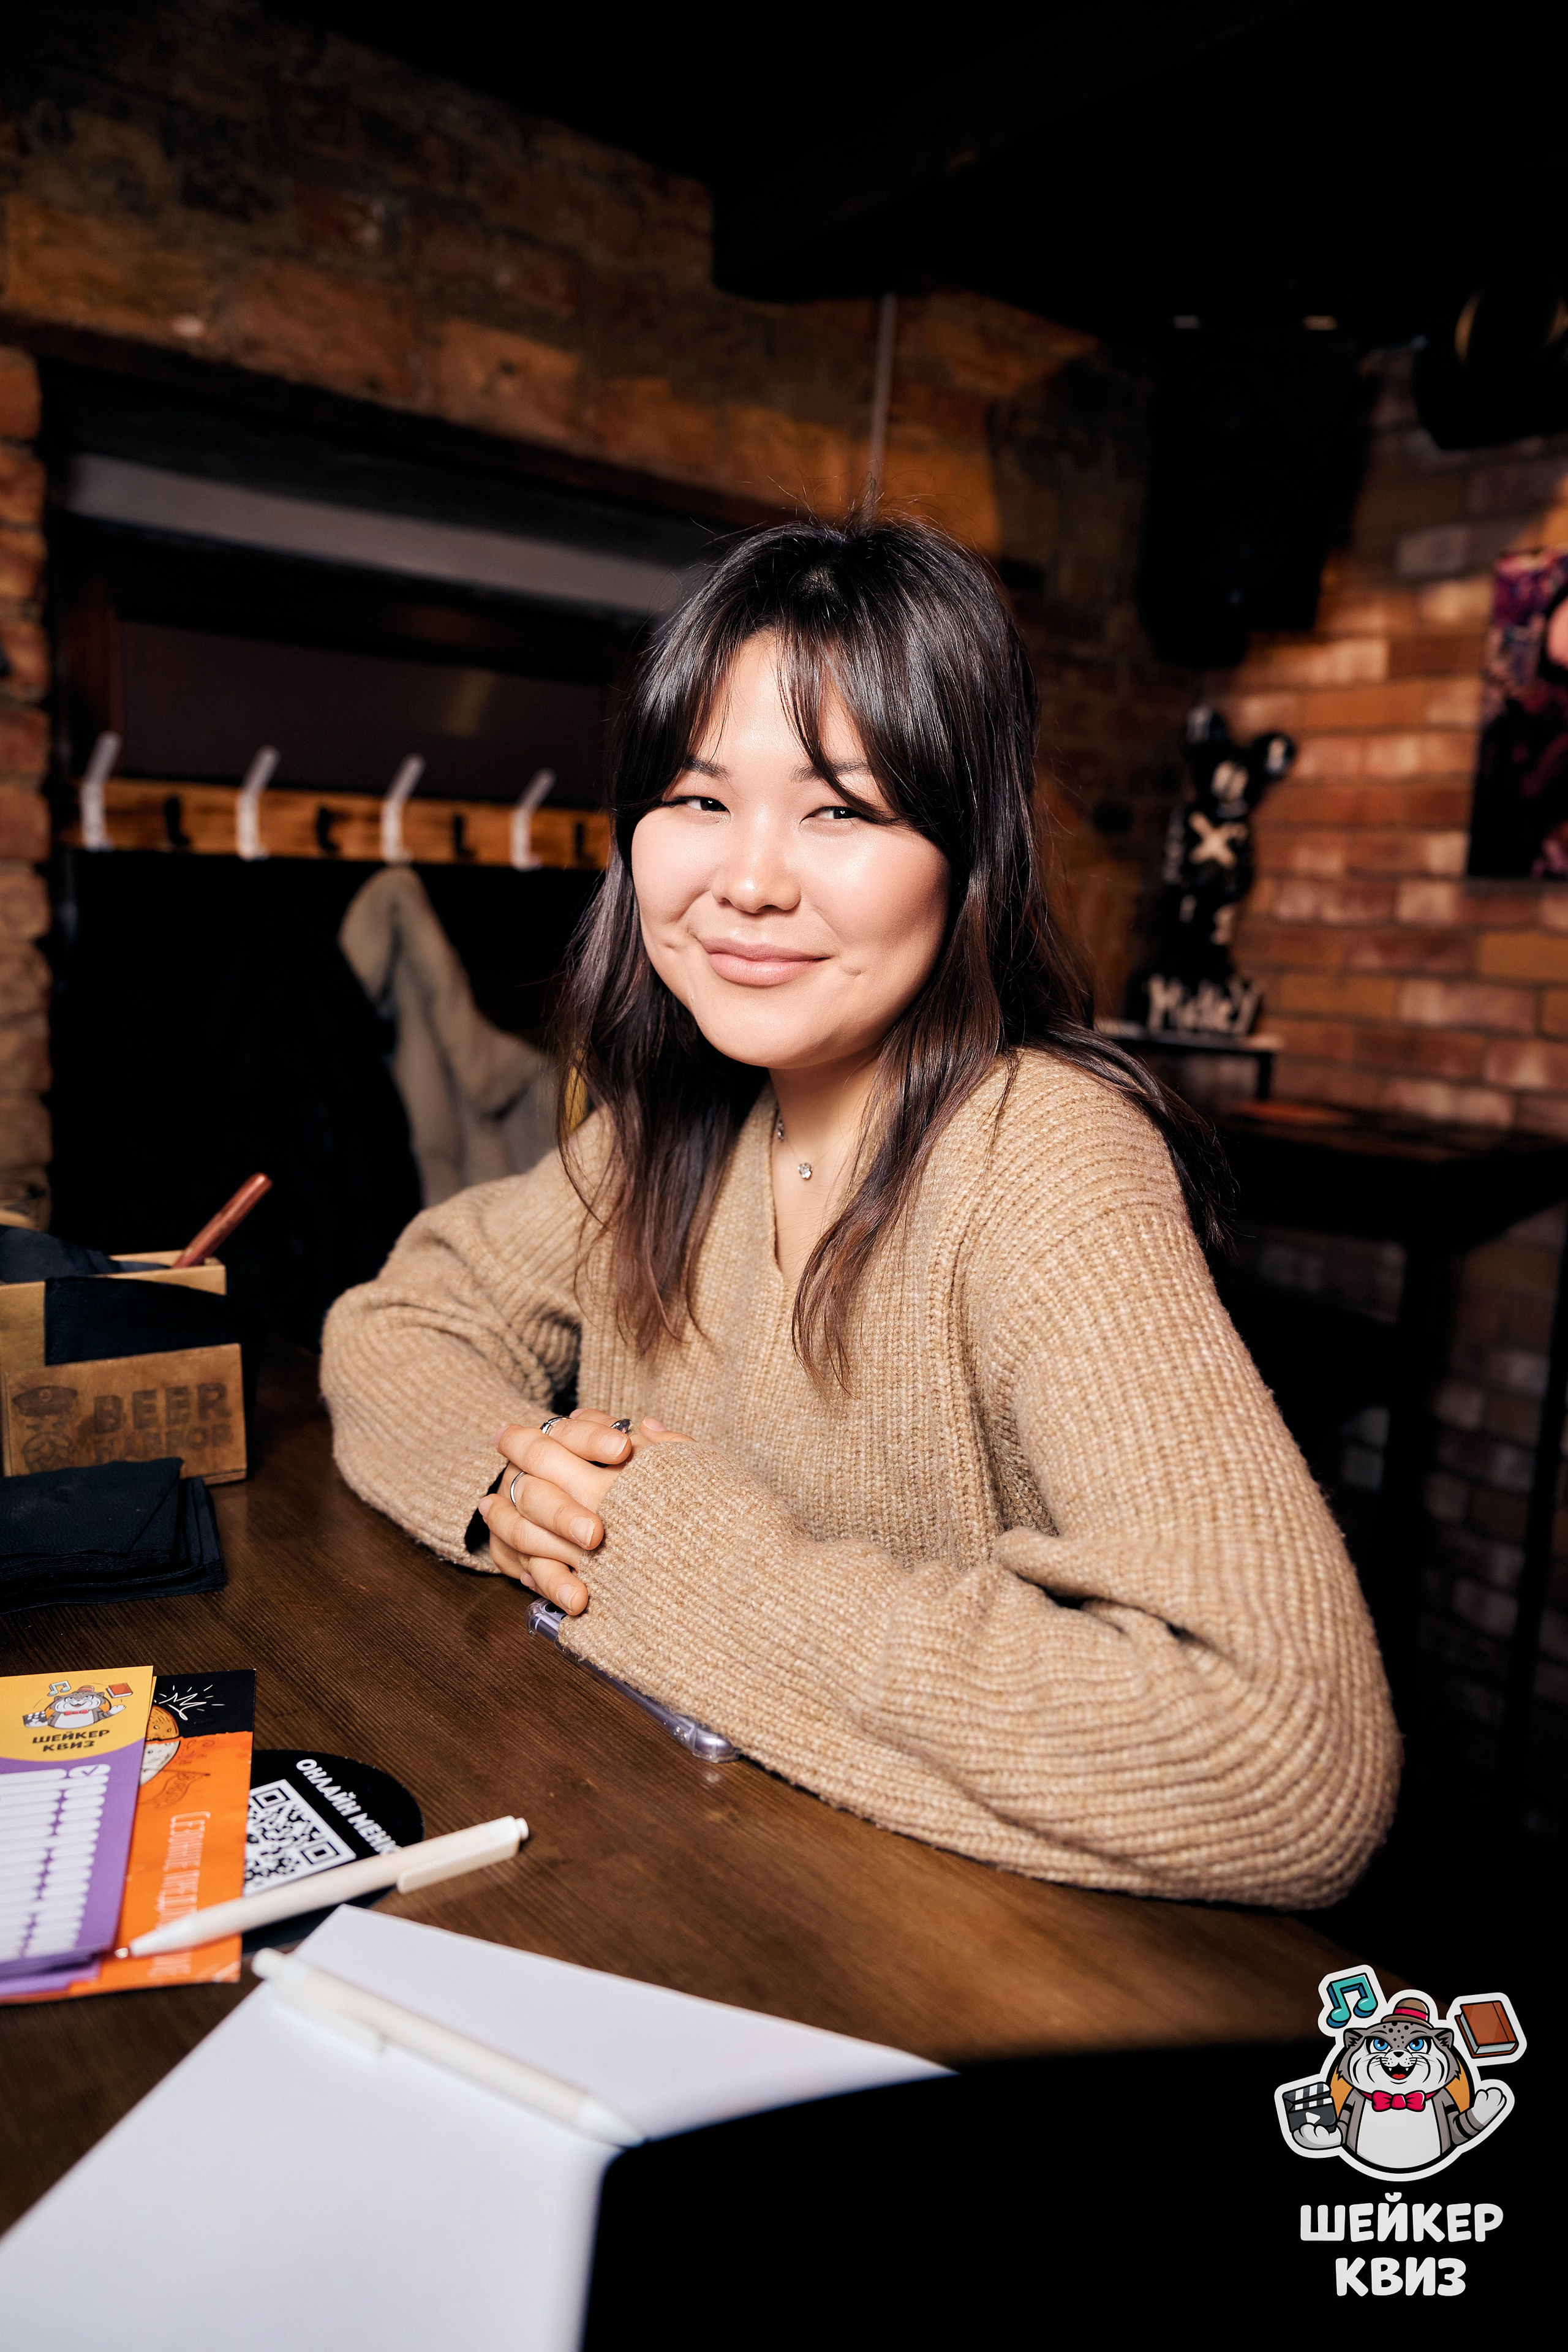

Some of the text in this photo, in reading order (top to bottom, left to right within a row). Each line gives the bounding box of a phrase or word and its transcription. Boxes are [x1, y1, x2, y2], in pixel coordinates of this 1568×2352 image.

[93, 1382, 232, 1435] BEER
[32, 1730, 110, 1744] ШЕЙКЕР
[42, 1740, 96, 1752] КВИЗ
[296, 1758, 361, 1817] ОНЛАЙН
